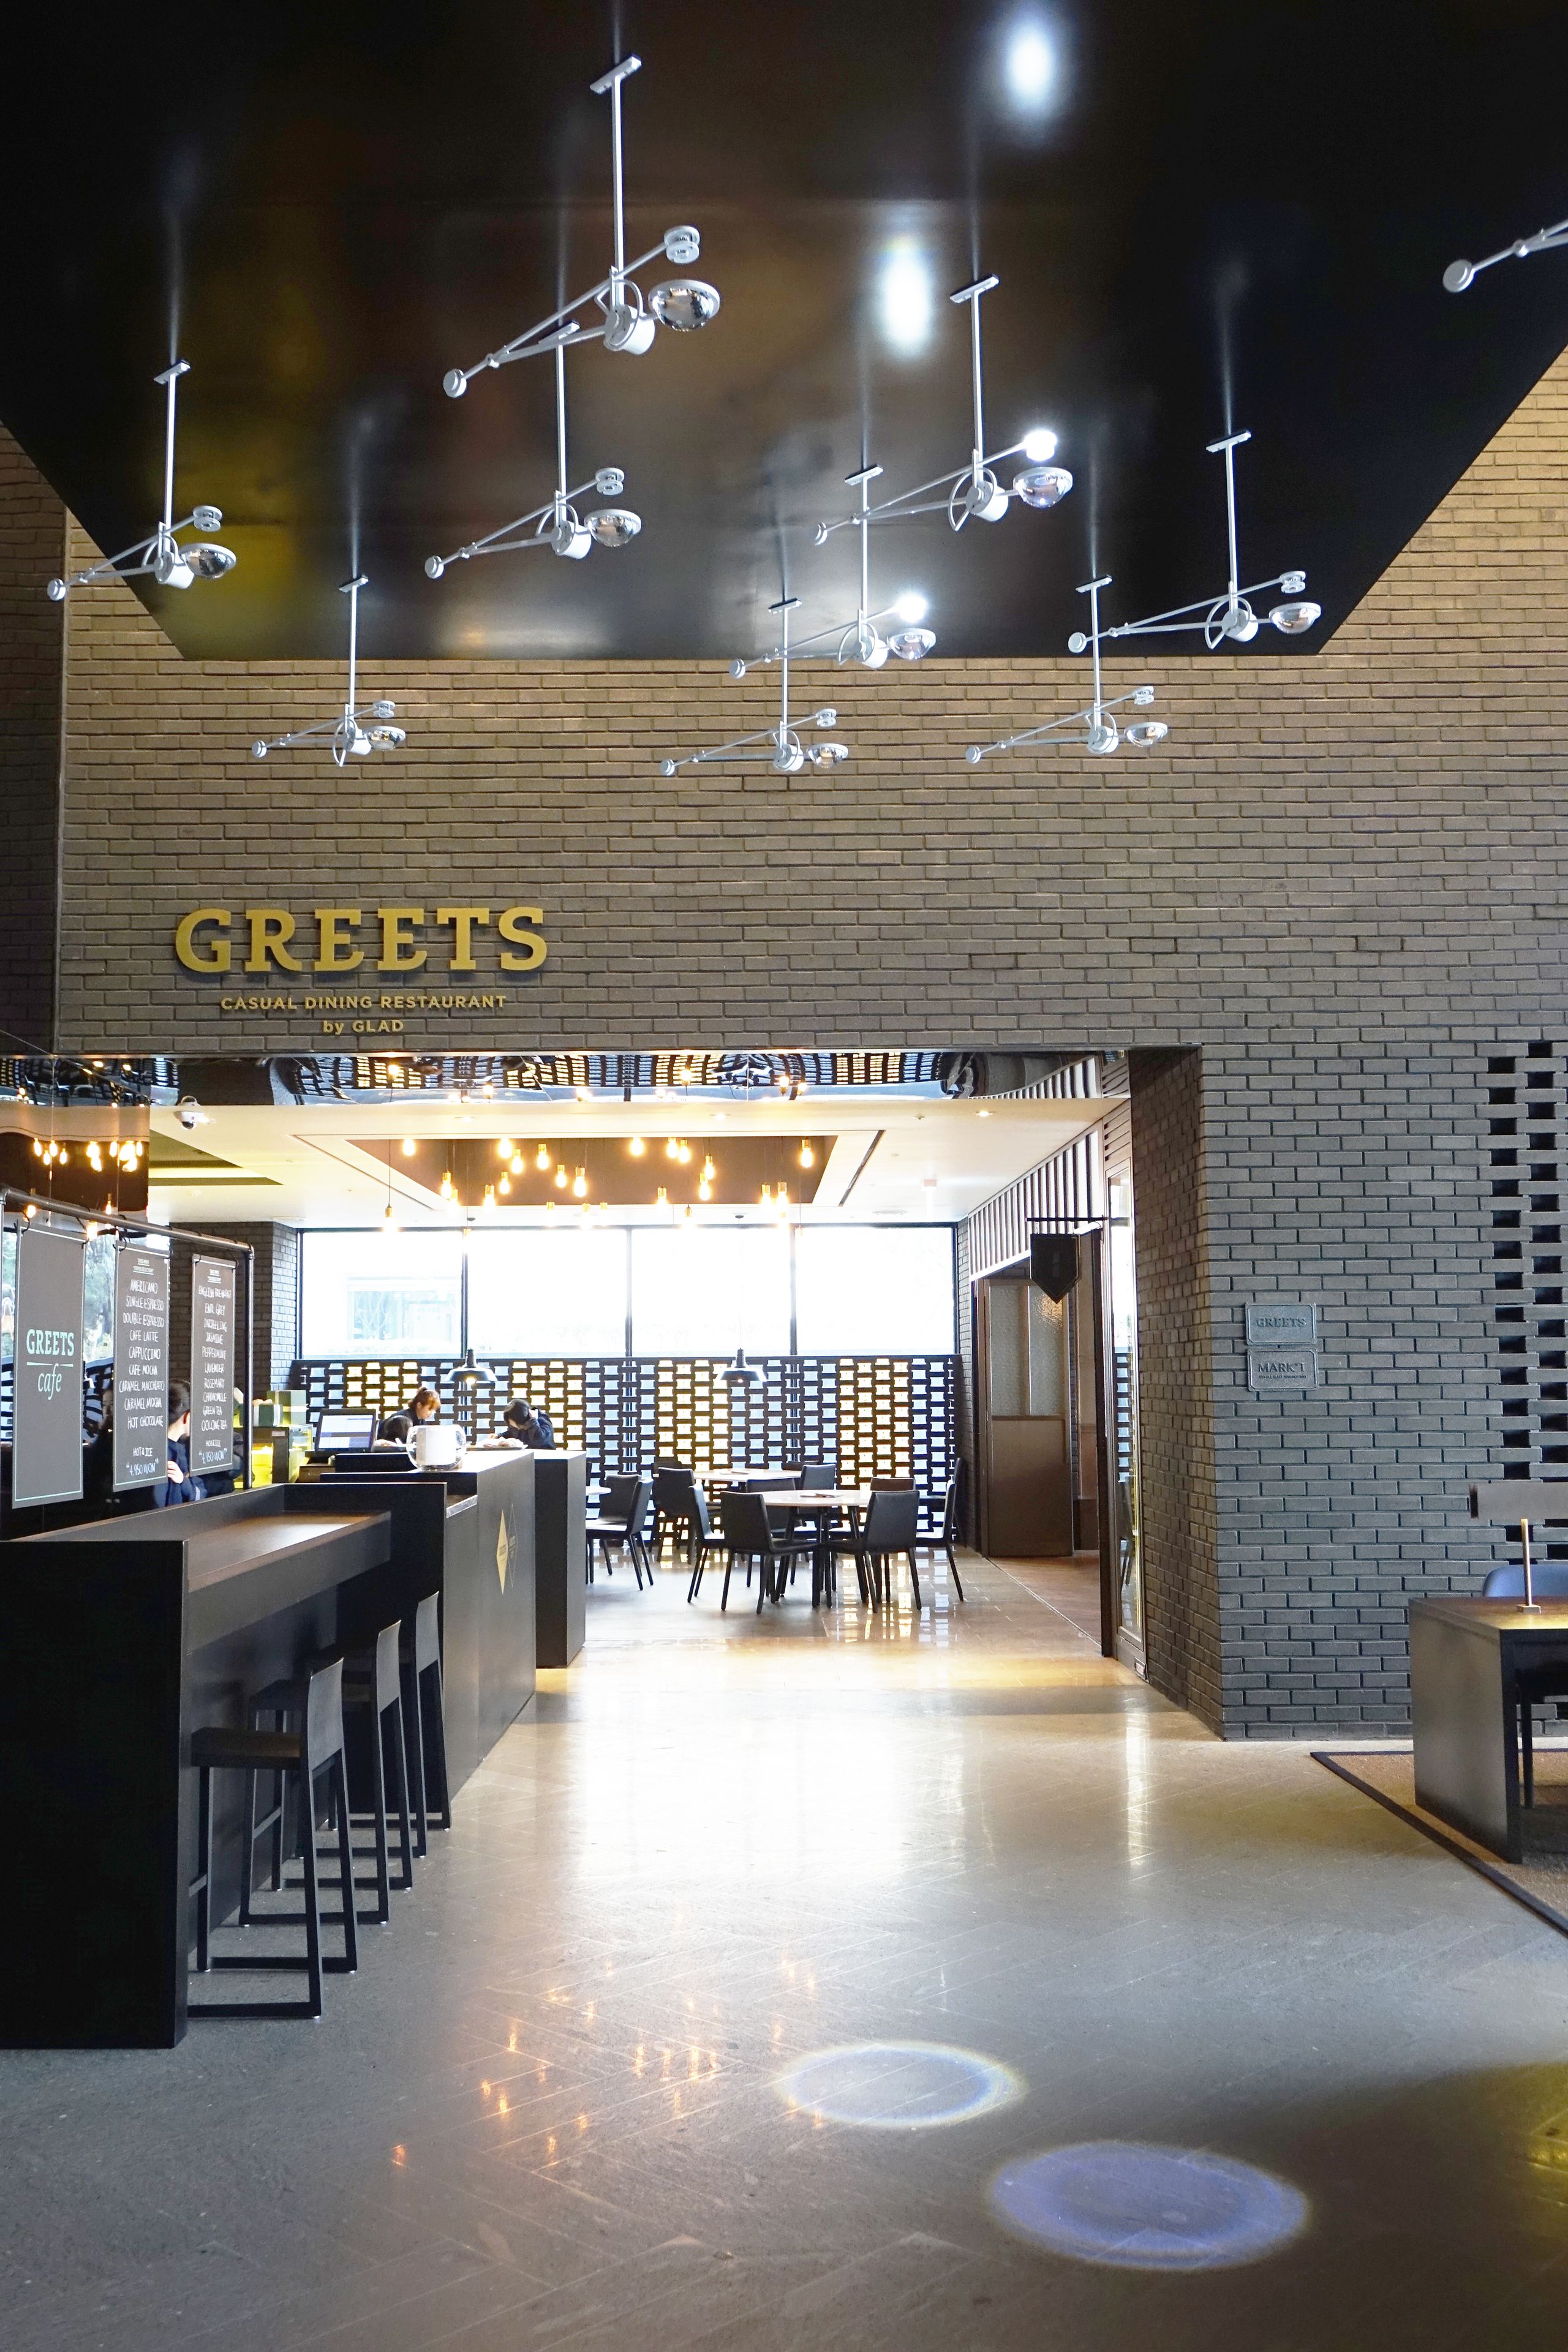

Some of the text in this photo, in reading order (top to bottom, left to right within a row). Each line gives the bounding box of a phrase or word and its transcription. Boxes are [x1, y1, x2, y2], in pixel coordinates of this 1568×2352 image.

[175, 907, 548, 973] GREETS
[221, 995, 507, 1010] CASUAL DINING RESTAURANT
[323, 1019, 404, 1035] by GLAD
[130, 1279, 158, 1294] AMERICANO
[126, 1295, 164, 1311] SINGLE ESPRESSO
[123, 1312, 164, 1327] DOUBLE ESPRESSO
[1256, 1317, 1306, 1328] GREETS
[26, 1329, 74, 1356] GREETS
[130, 1329, 159, 1342] CAFE LATTE
[129, 1346, 161, 1360] CAPPUCCINO
[129, 1364, 158, 1376] CAFE MOCHA
[38, 1363, 62, 1400] cafe
[119, 1380, 165, 1393] CARAMEL MACCHIATO
[124, 1397, 162, 1411] CARAMEL MOCHA
[127, 1415, 164, 1430] HOT CHOCOLATE
